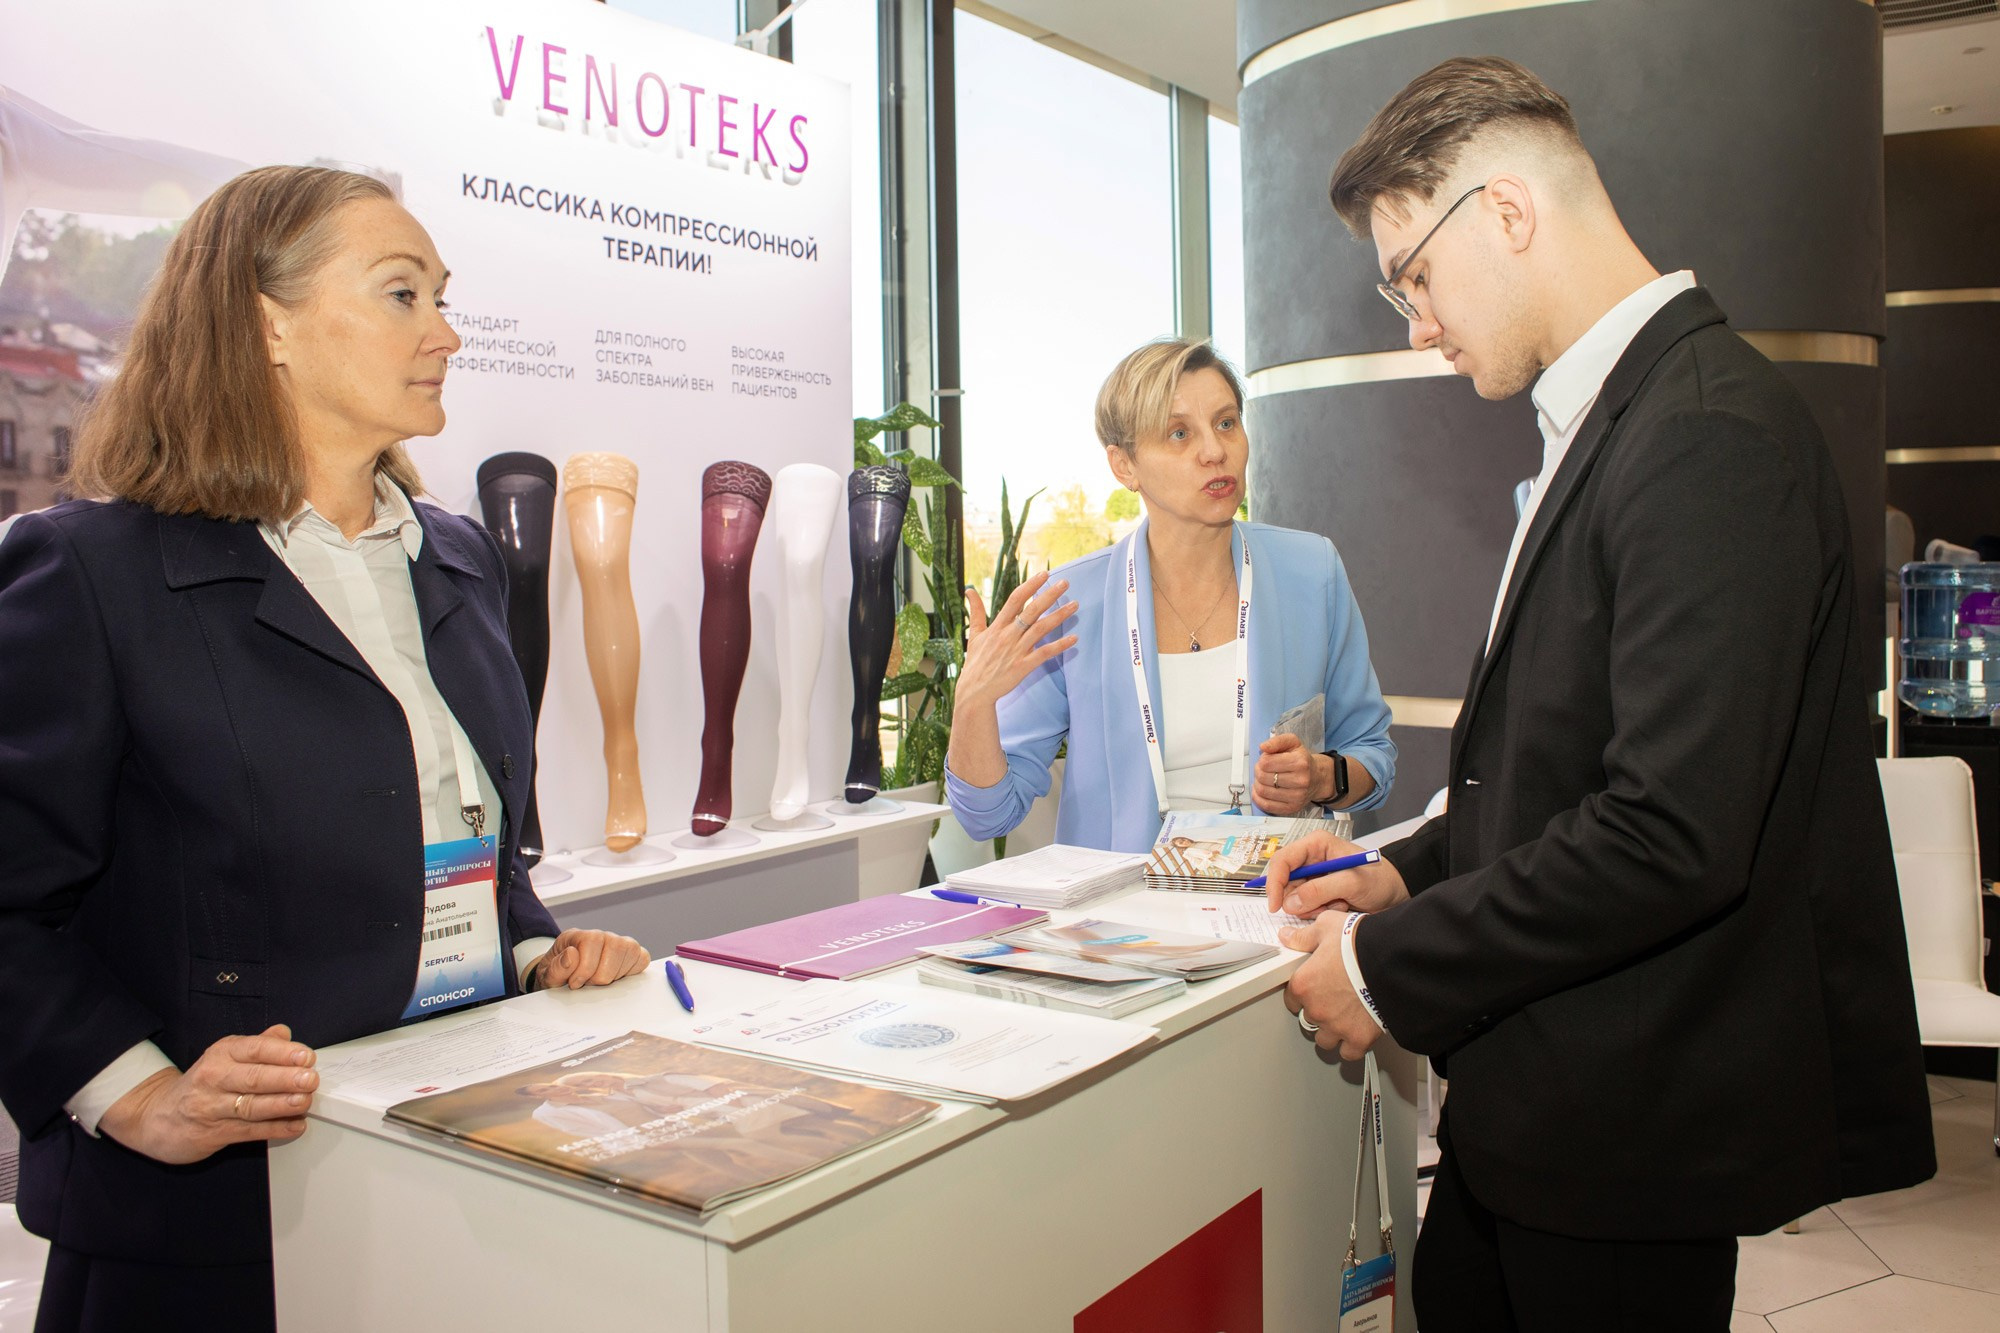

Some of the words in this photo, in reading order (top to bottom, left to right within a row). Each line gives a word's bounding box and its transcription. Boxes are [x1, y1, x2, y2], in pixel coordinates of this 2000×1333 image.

[486, 25, 810, 175] VENOTEKS
[462, 172, 605, 222] КЛАССИКА
[611, 202, 818, 262] КОМПРЕССИОННОЙ
[603, 236, 712, 275] ТЕРАПИИ!
[459, 335, 556, 358] ИНИЧЕСКОЙ
[595, 329, 622, 346] ДЛЯ
[625, 332, 686, 353] ПОЛНОГО
[595, 351, 653, 367] СПЕКТРА
[731, 345, 785, 364] ВЫСОКАЯ
[447, 356, 575, 380] ЭФФЕКТИВНОСТИ
[731, 364, 832, 387] ПРИВЕРЖЕННОСТЬ
[595, 369, 689, 390] ЗАБОЛЕВАНИЙ
[691, 377, 714, 392] ВЕН
[731, 381, 798, 400] ПАЦИЕНТОВ
[1127, 559, 1135, 593] SERVIER
[1239, 601, 1249, 639] SERVIER
[1131, 629, 1141, 666] SERVIER
[1237, 679, 1246, 719] SERVIER
[1142, 704, 1155, 743] SERVIER
[424, 875, 448, 886] ОГИИ
[425, 867, 447, 877] НЫЕ
[447, 860, 492, 874] ВОПРОСЫ
[435, 909, 478, 924] Анатольевна
[819, 920, 926, 949] VENOTEKS
[425, 954, 464, 968] SERVIER
[420, 987, 475, 1007] СПОНСОР
[775, 1000, 896, 1043] ФЛЕБОЛОГИЯ
[1374, 1094, 1382, 1145] SERVIER
